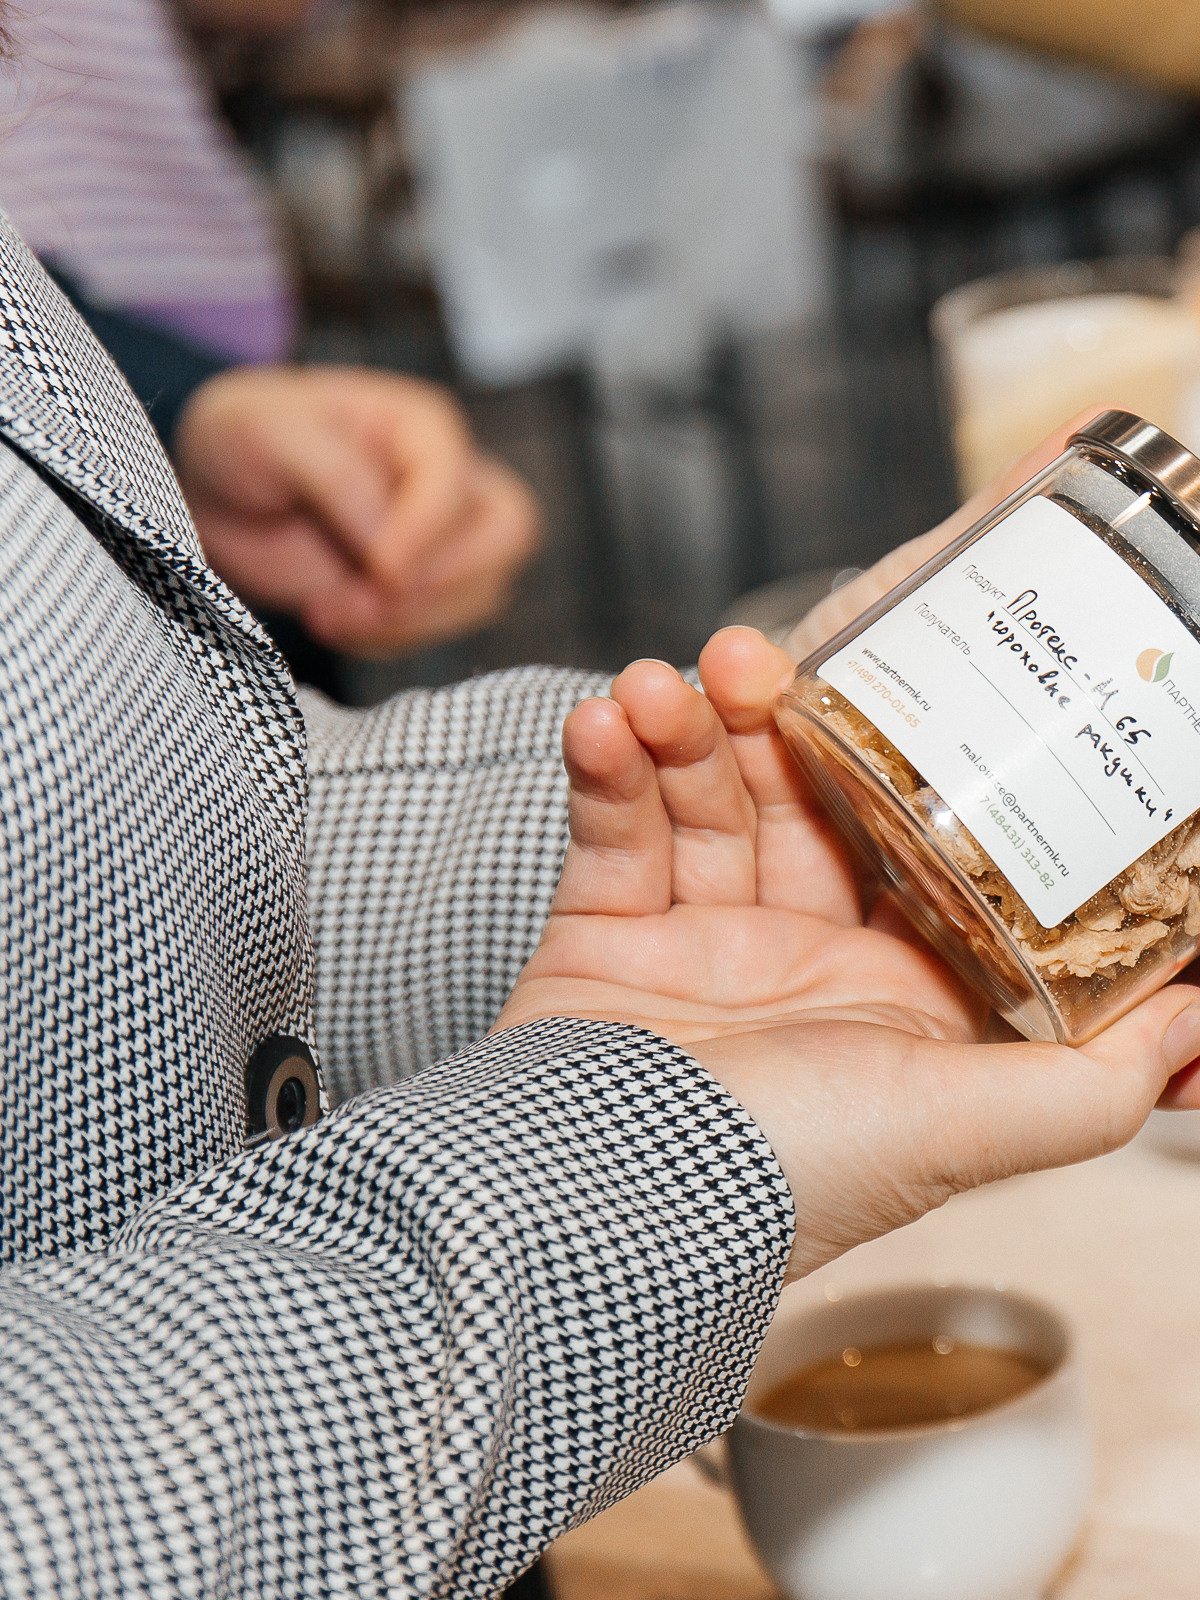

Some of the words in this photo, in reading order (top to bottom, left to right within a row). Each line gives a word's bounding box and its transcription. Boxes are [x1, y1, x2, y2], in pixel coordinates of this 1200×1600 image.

[962, 564, 1007, 601] Продукт
[913, 602, 971, 656] Получатель
[861, 647, 932, 712] www.partnermk.ru
[1115, 715, 1152, 745] 65
[985, 803, 1026, 850] (48431)
[1020, 848, 1055, 890] 313-82
